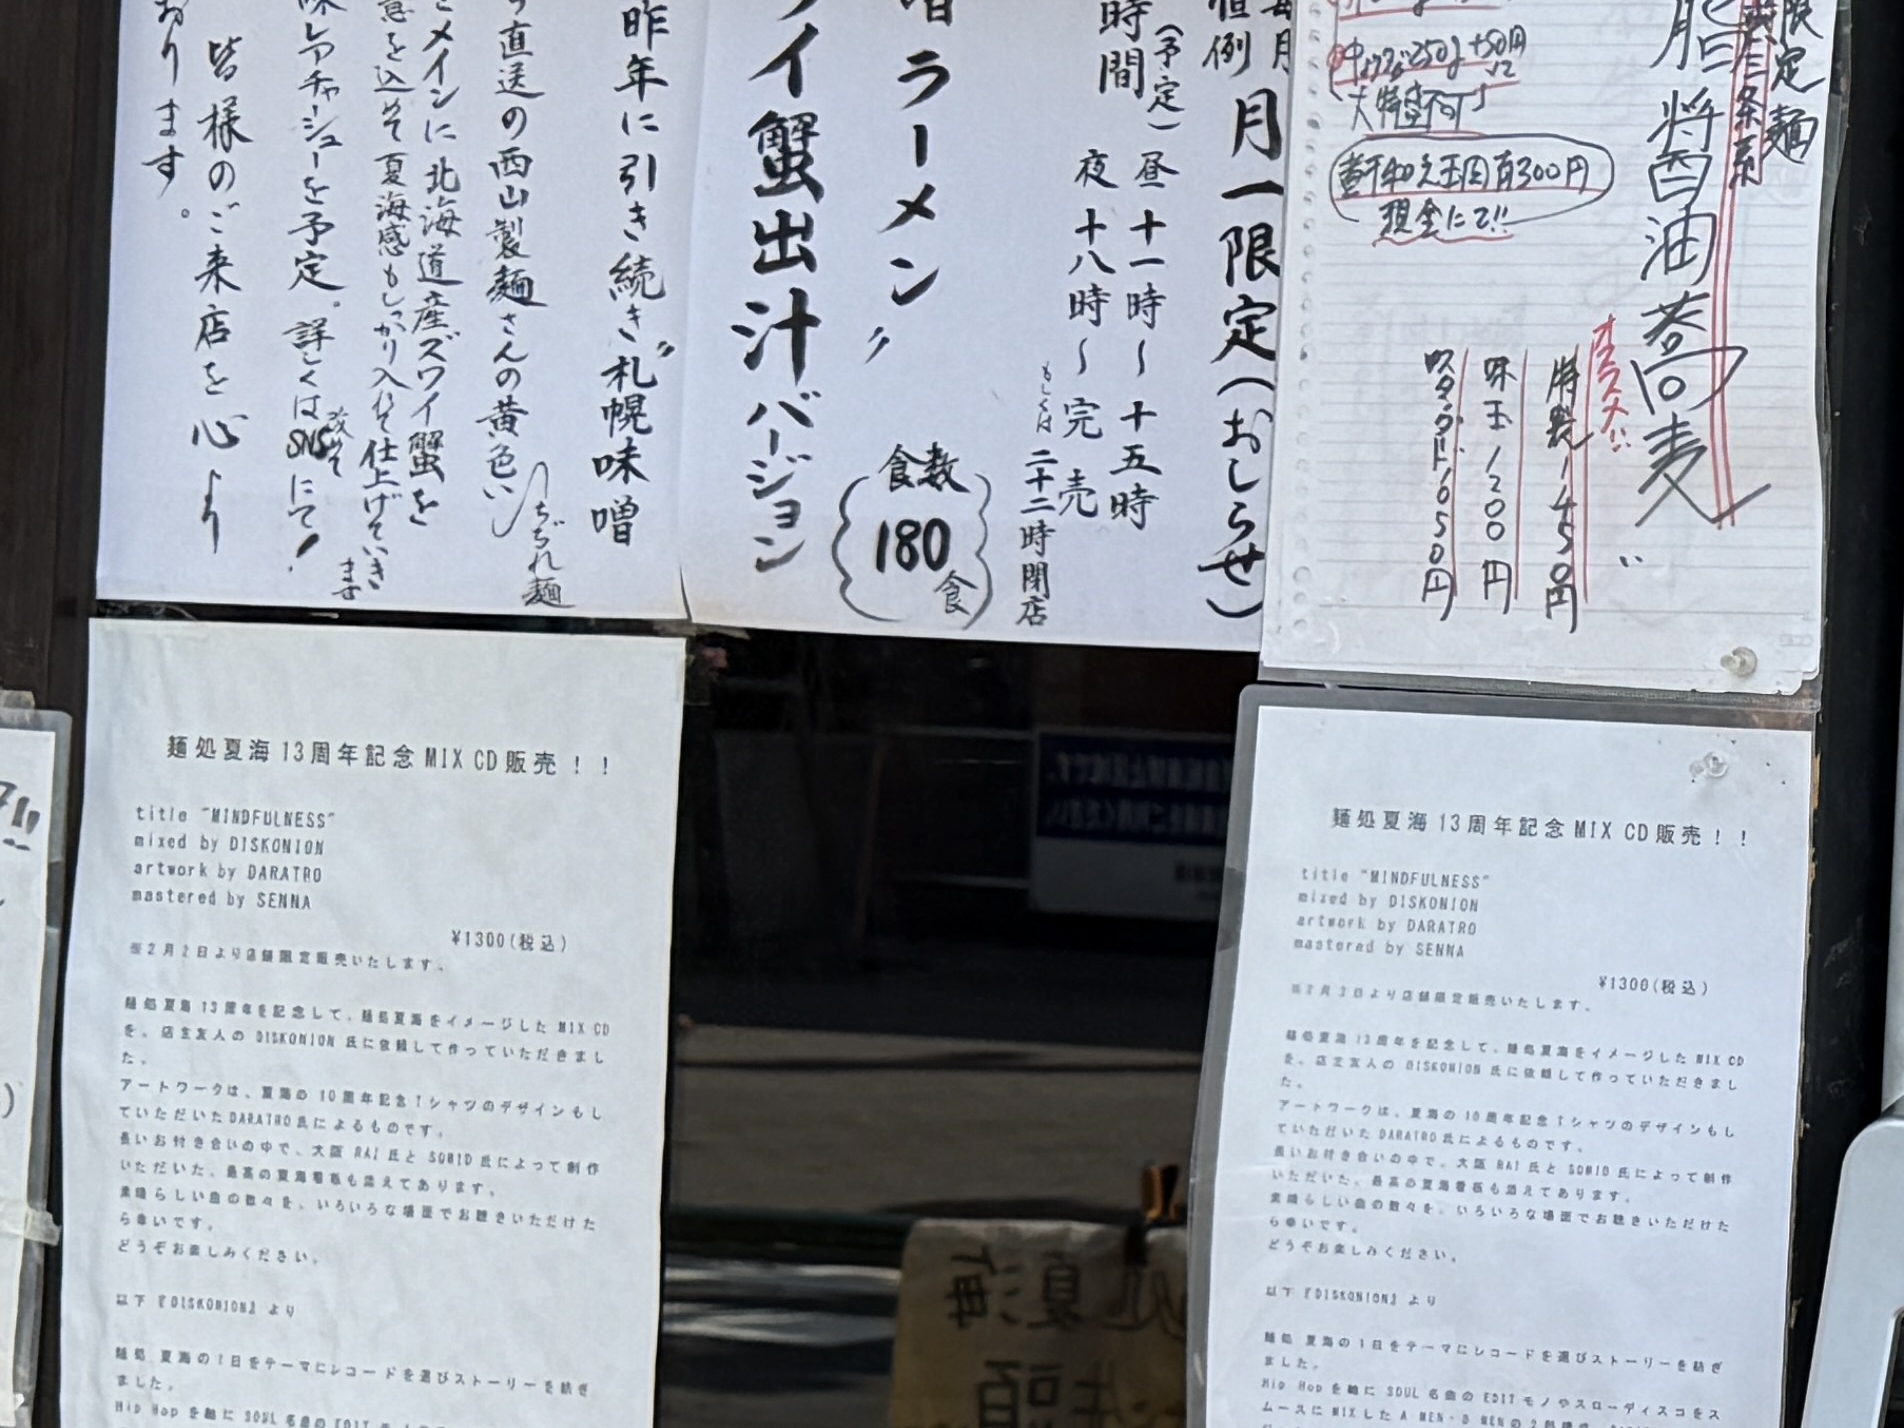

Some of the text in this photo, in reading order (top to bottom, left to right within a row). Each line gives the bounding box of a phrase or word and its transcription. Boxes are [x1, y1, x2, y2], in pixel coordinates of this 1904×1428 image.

[876, 443, 965, 498] 食数
[874, 516, 951, 574] 180
[137, 805, 187, 823] title
[134, 834, 325, 856] mixed by DISKONION
[247, 865, 322, 883] DARATRO
[132, 887, 311, 910] mastered by SENNA
[1416, 942, 1464, 959] SENNA
